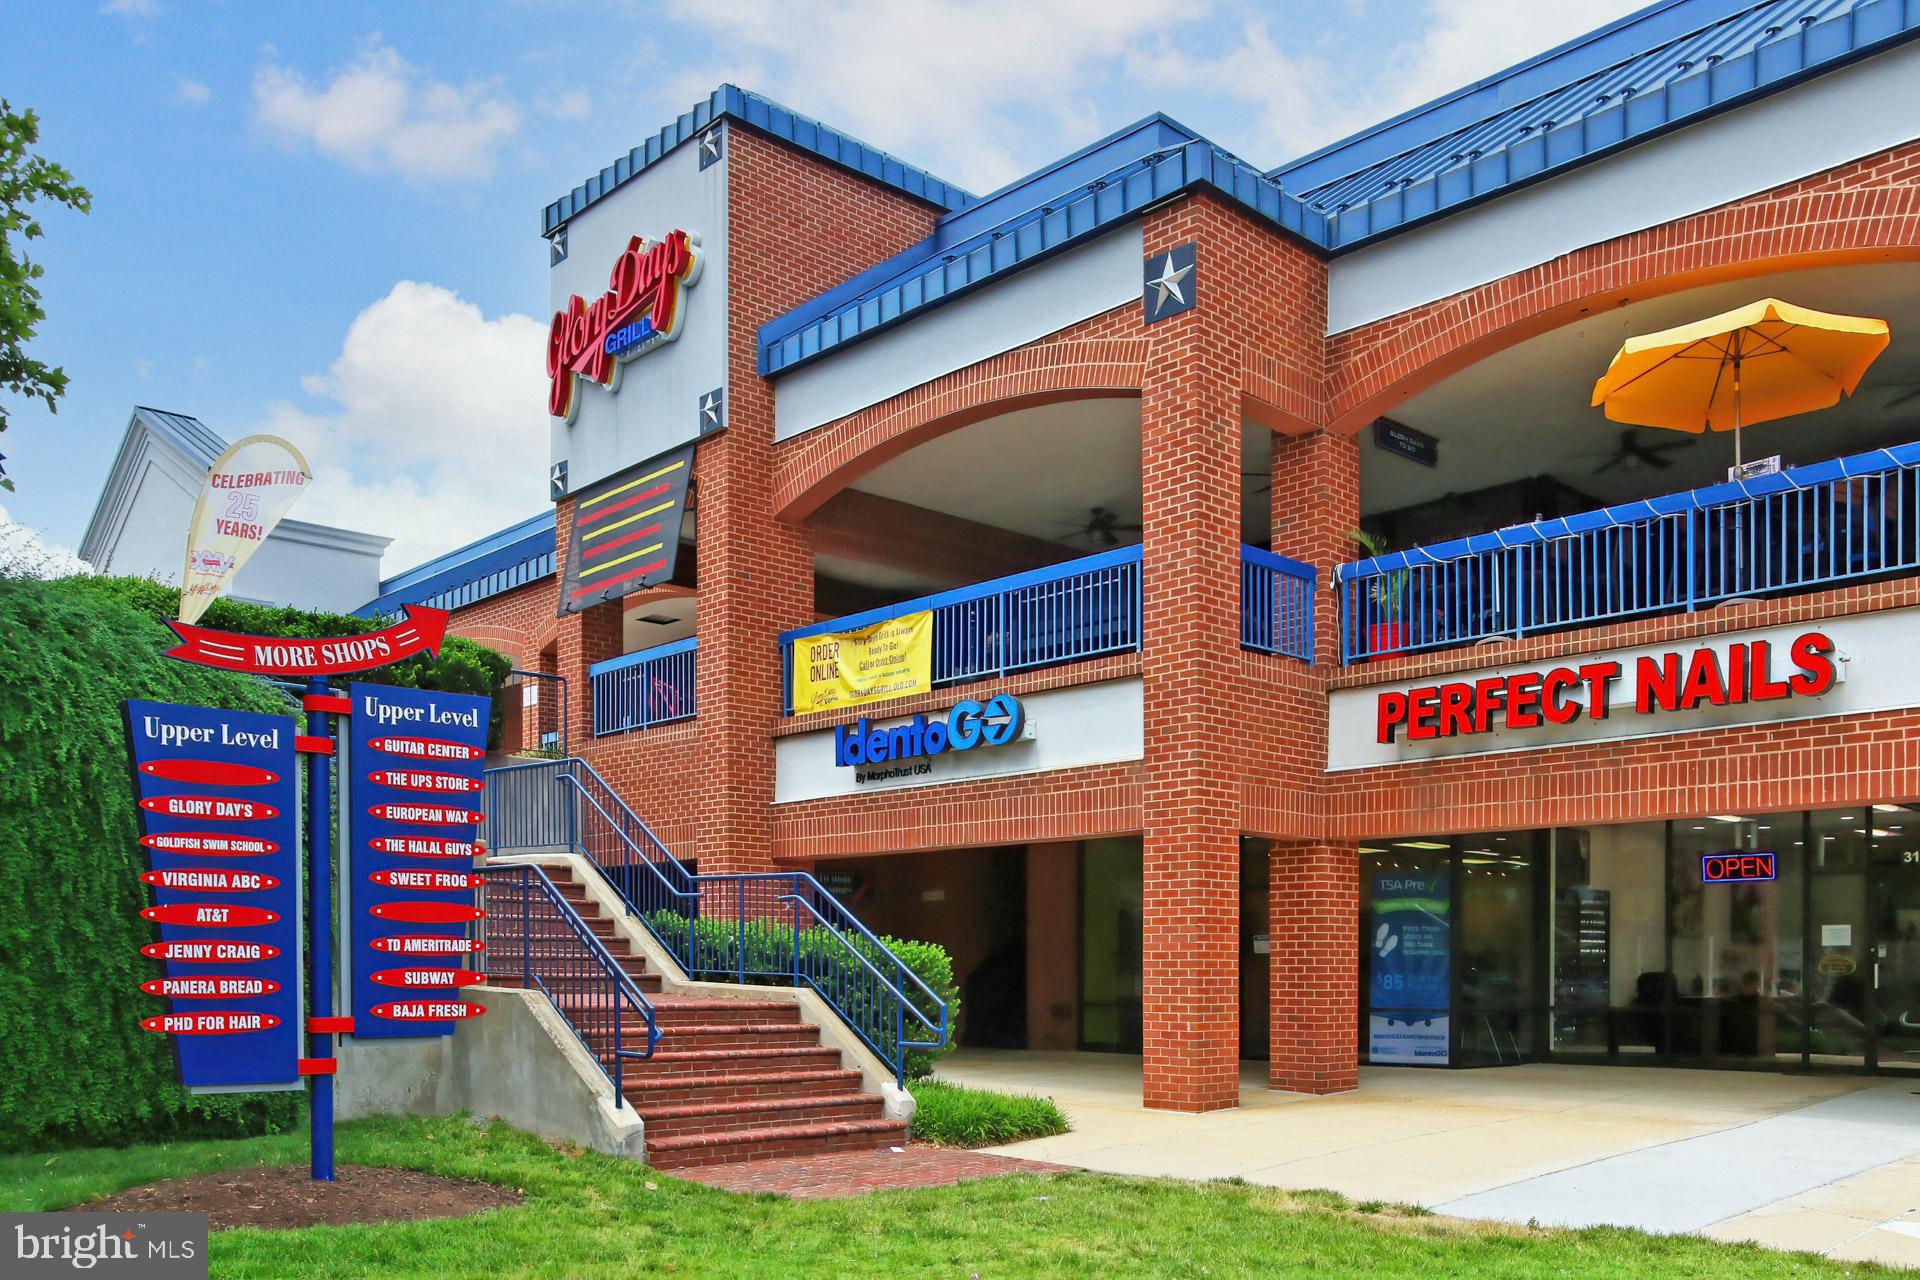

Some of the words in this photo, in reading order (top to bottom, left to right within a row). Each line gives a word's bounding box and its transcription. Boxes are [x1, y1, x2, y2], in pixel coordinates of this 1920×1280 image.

[547, 290, 619, 417] Glory
[608, 228, 692, 332] Days
[605, 316, 652, 353] GRILL
[211, 471, 305, 488] CELEBRATING
[226, 492, 260, 521] 25
[216, 518, 263, 540] YEARS!
[254, 645, 318, 667] MORE
[321, 636, 390, 665] SHOPS
[810, 642, 840, 662] ORDER
[810, 661, 840, 682] ONLINE
[1377, 661, 1622, 744] PERFECT
[1635, 632, 1836, 714] NAILS
[365, 695, 424, 725] Upper
[429, 703, 479, 727] Level
[143, 716, 215, 747] Upper
[221, 723, 279, 749] Level
[384, 739, 425, 755] GUITAR
[428, 743, 469, 759] CENTER
[386, 772, 407, 786] THE
[410, 774, 433, 787] UPS
[435, 776, 469, 791] STORE
[856, 772, 866, 784] By
[867, 766, 913, 782] MorphoTrust
[914, 763, 932, 775] USA
[169, 798, 212, 815] GLORY
[216, 801, 253, 817] DAY'S
[386, 806, 442, 822] EUROPEAN
[445, 810, 468, 823] WAX
[156, 837, 200, 849] GOLDFISH
[203, 839, 228, 850] SWIM
[231, 841, 265, 852] SCHOOL
[385, 839, 405, 852] THE
[408, 840, 442, 854] HALAL
[445, 843, 472, 856] GUYS
[1706, 856, 1773, 879] OPEN
[162, 872, 227, 887] VIRGINIA
[231, 875, 260, 889] ABC
[390, 872, 431, 886] SWEET
[435, 874, 467, 887] FROG
[1380, 879, 1401, 890] TSA
[1405, 879, 1425, 890] Pre
[197, 908, 229, 922] AT&T
[164, 945, 212, 959] JENNY
[216, 945, 260, 959] CRAIG
[387, 939, 400, 951] TD
[404, 939, 472, 952] AMERITRADE
[163, 980, 216, 994] PANERA
[220, 980, 263, 994] BREAD
[404, 972, 455, 984] SUBWAY
[393, 1005, 423, 1017] BAJA
[428, 1004, 467, 1017] FRESH
[164, 1017, 193, 1031] PHD
[197, 1016, 225, 1030] FOR
[229, 1015, 261, 1029] HAIR
